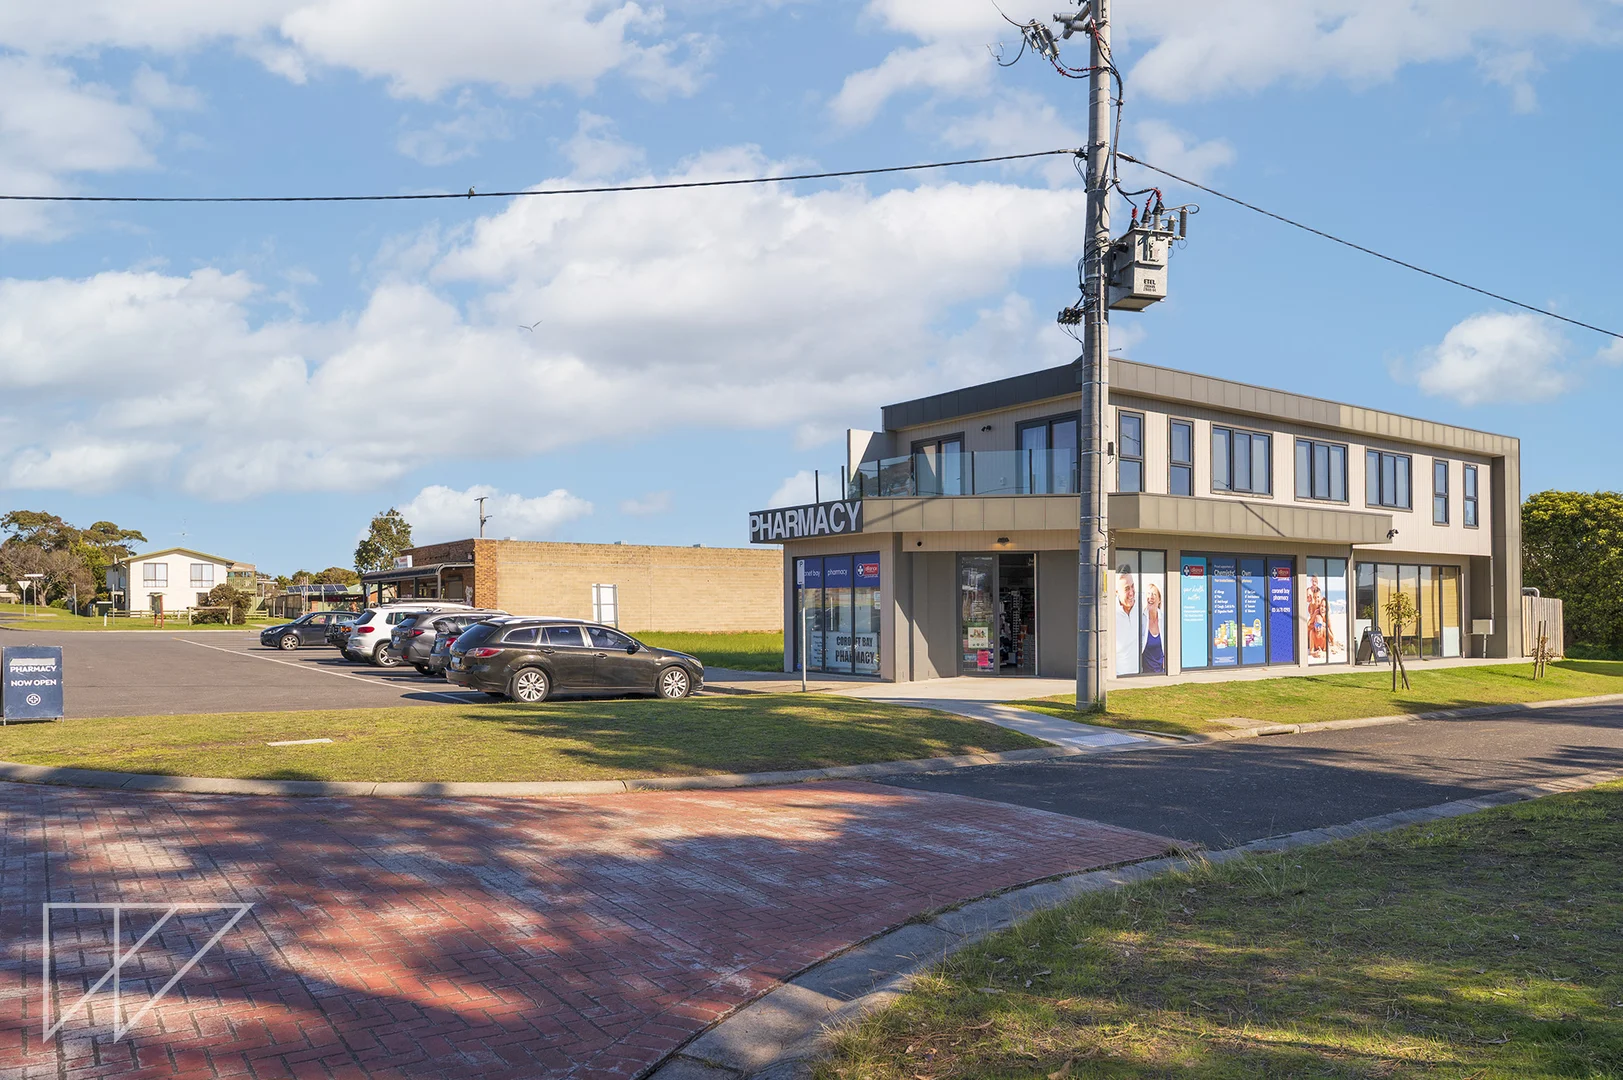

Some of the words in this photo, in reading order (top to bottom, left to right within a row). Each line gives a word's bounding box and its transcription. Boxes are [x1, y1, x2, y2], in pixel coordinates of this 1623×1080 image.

[748, 501, 862, 541] PHARMACY
[827, 569, 847, 577] pharmacy
[836, 636, 861, 646] COROET
[862, 637, 873, 647] BAY
[835, 650, 875, 664] PHAMACY
